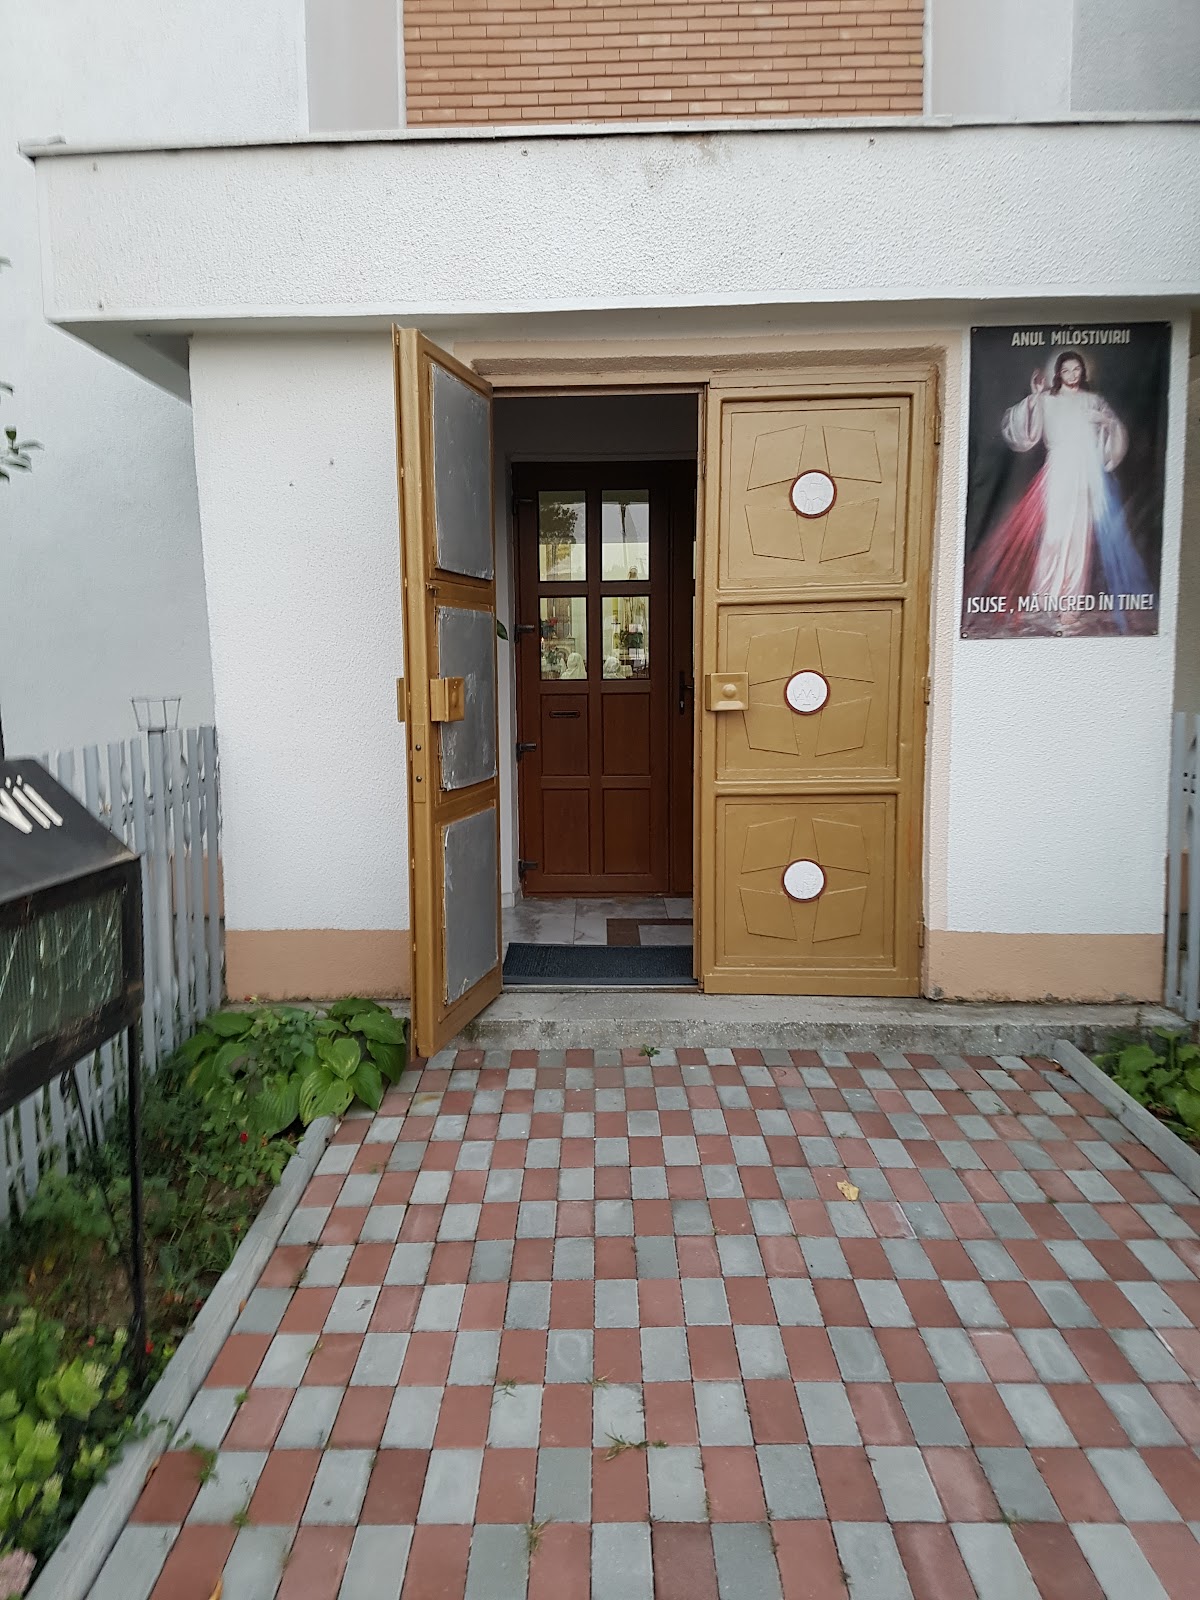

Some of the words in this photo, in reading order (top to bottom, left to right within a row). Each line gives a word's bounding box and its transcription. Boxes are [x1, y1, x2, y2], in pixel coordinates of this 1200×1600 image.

[1011, 331, 1045, 346] ANUL
[1051, 329, 1130, 346] MILOSTIVIRII
[1018, 593, 1040, 612] MĂ
[1044, 593, 1095, 612] ÎNCRED
[1098, 592, 1113, 611] ÎN
[1118, 594, 1154, 611] TINE!
